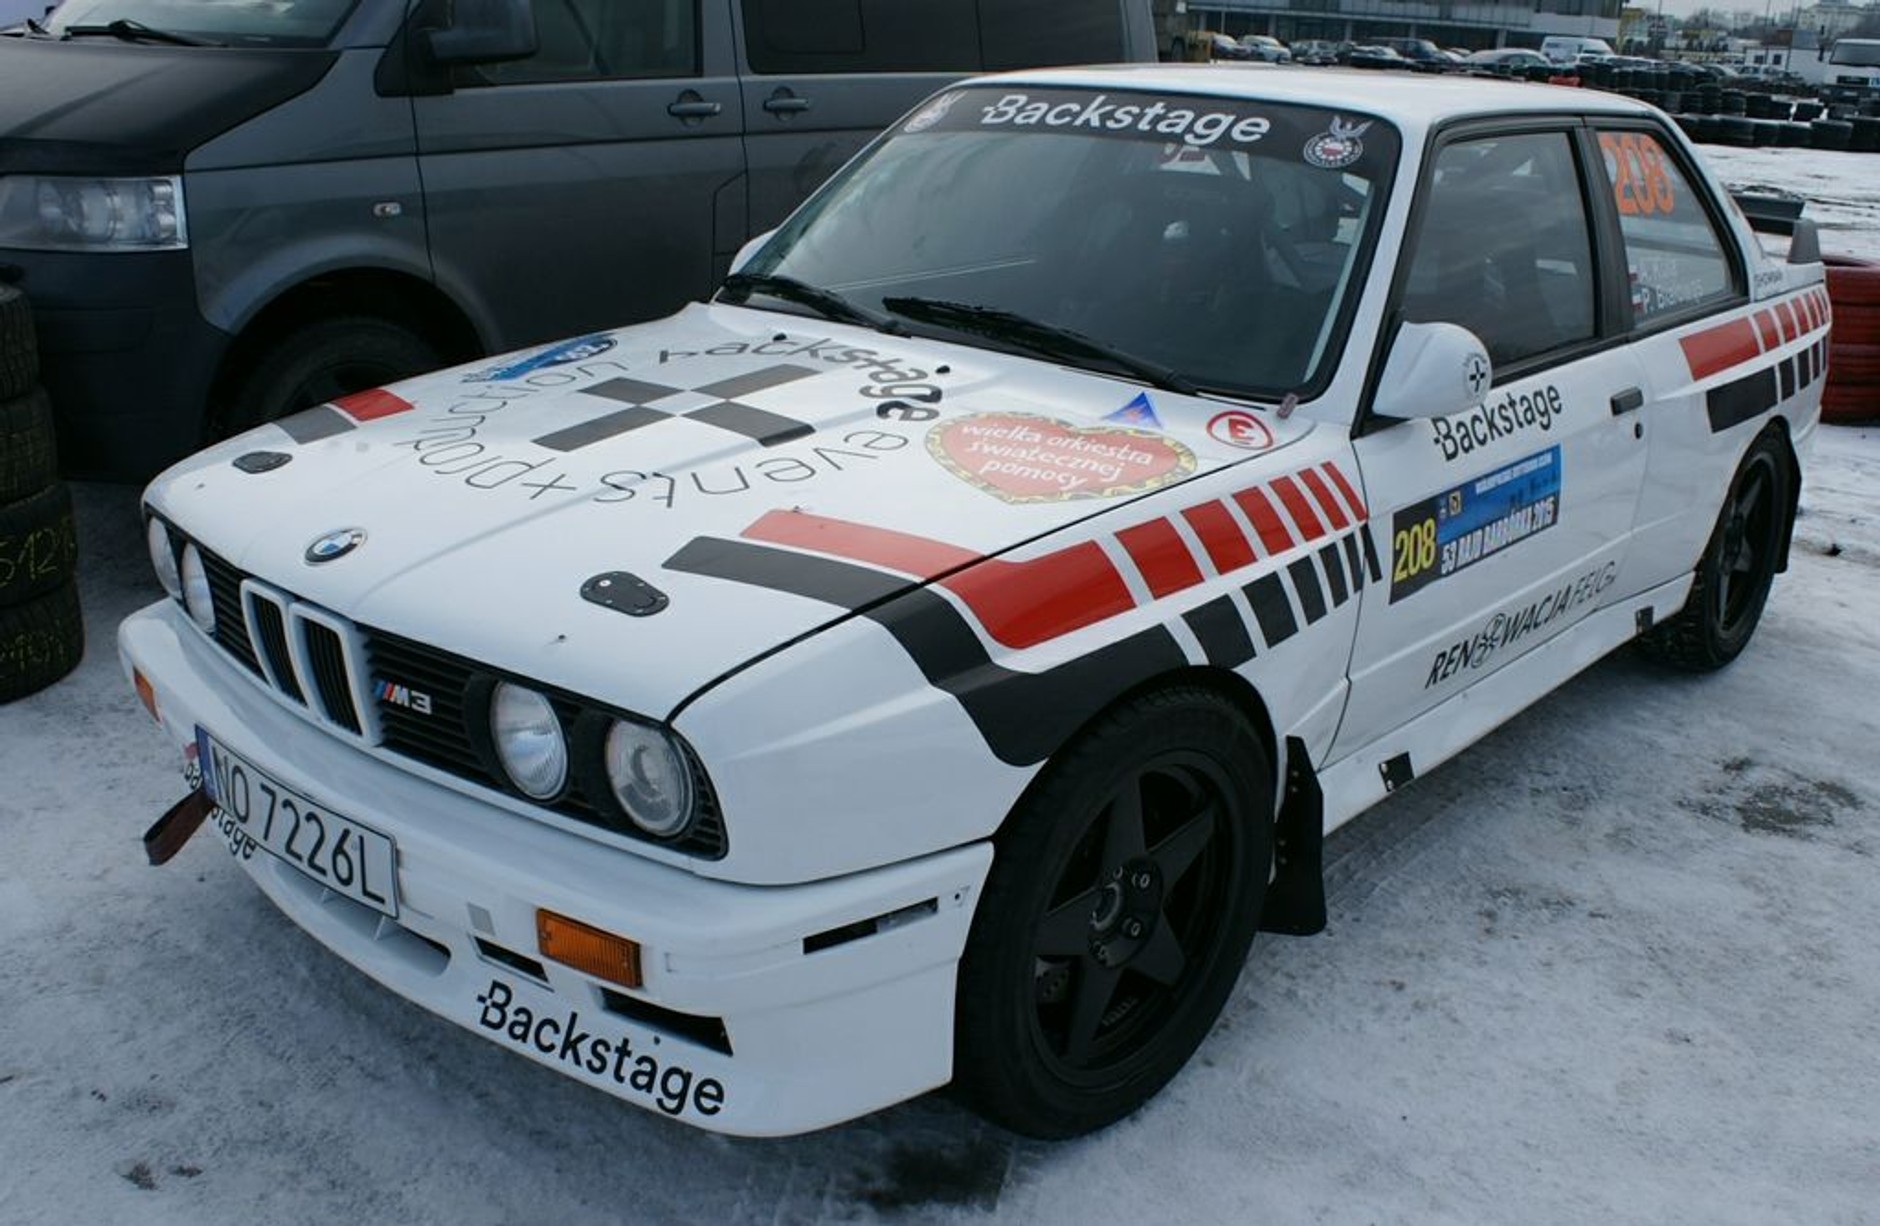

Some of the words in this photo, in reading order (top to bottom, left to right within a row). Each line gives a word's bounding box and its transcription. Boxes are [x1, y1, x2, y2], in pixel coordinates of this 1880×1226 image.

[981, 94, 1271, 145] Backstage
[1598, 132, 1674, 216] 208
[961, 423, 1043, 444] wielka
[1047, 436, 1155, 466] orkiestra
[1430, 385, 1562, 462] Backstage
[979, 460, 1089, 491] pomocy
[1393, 517, 1437, 584] 208
[213, 746, 249, 823] NO
[260, 782, 386, 905] 7226L
[476, 980, 725, 1116] Backstage
